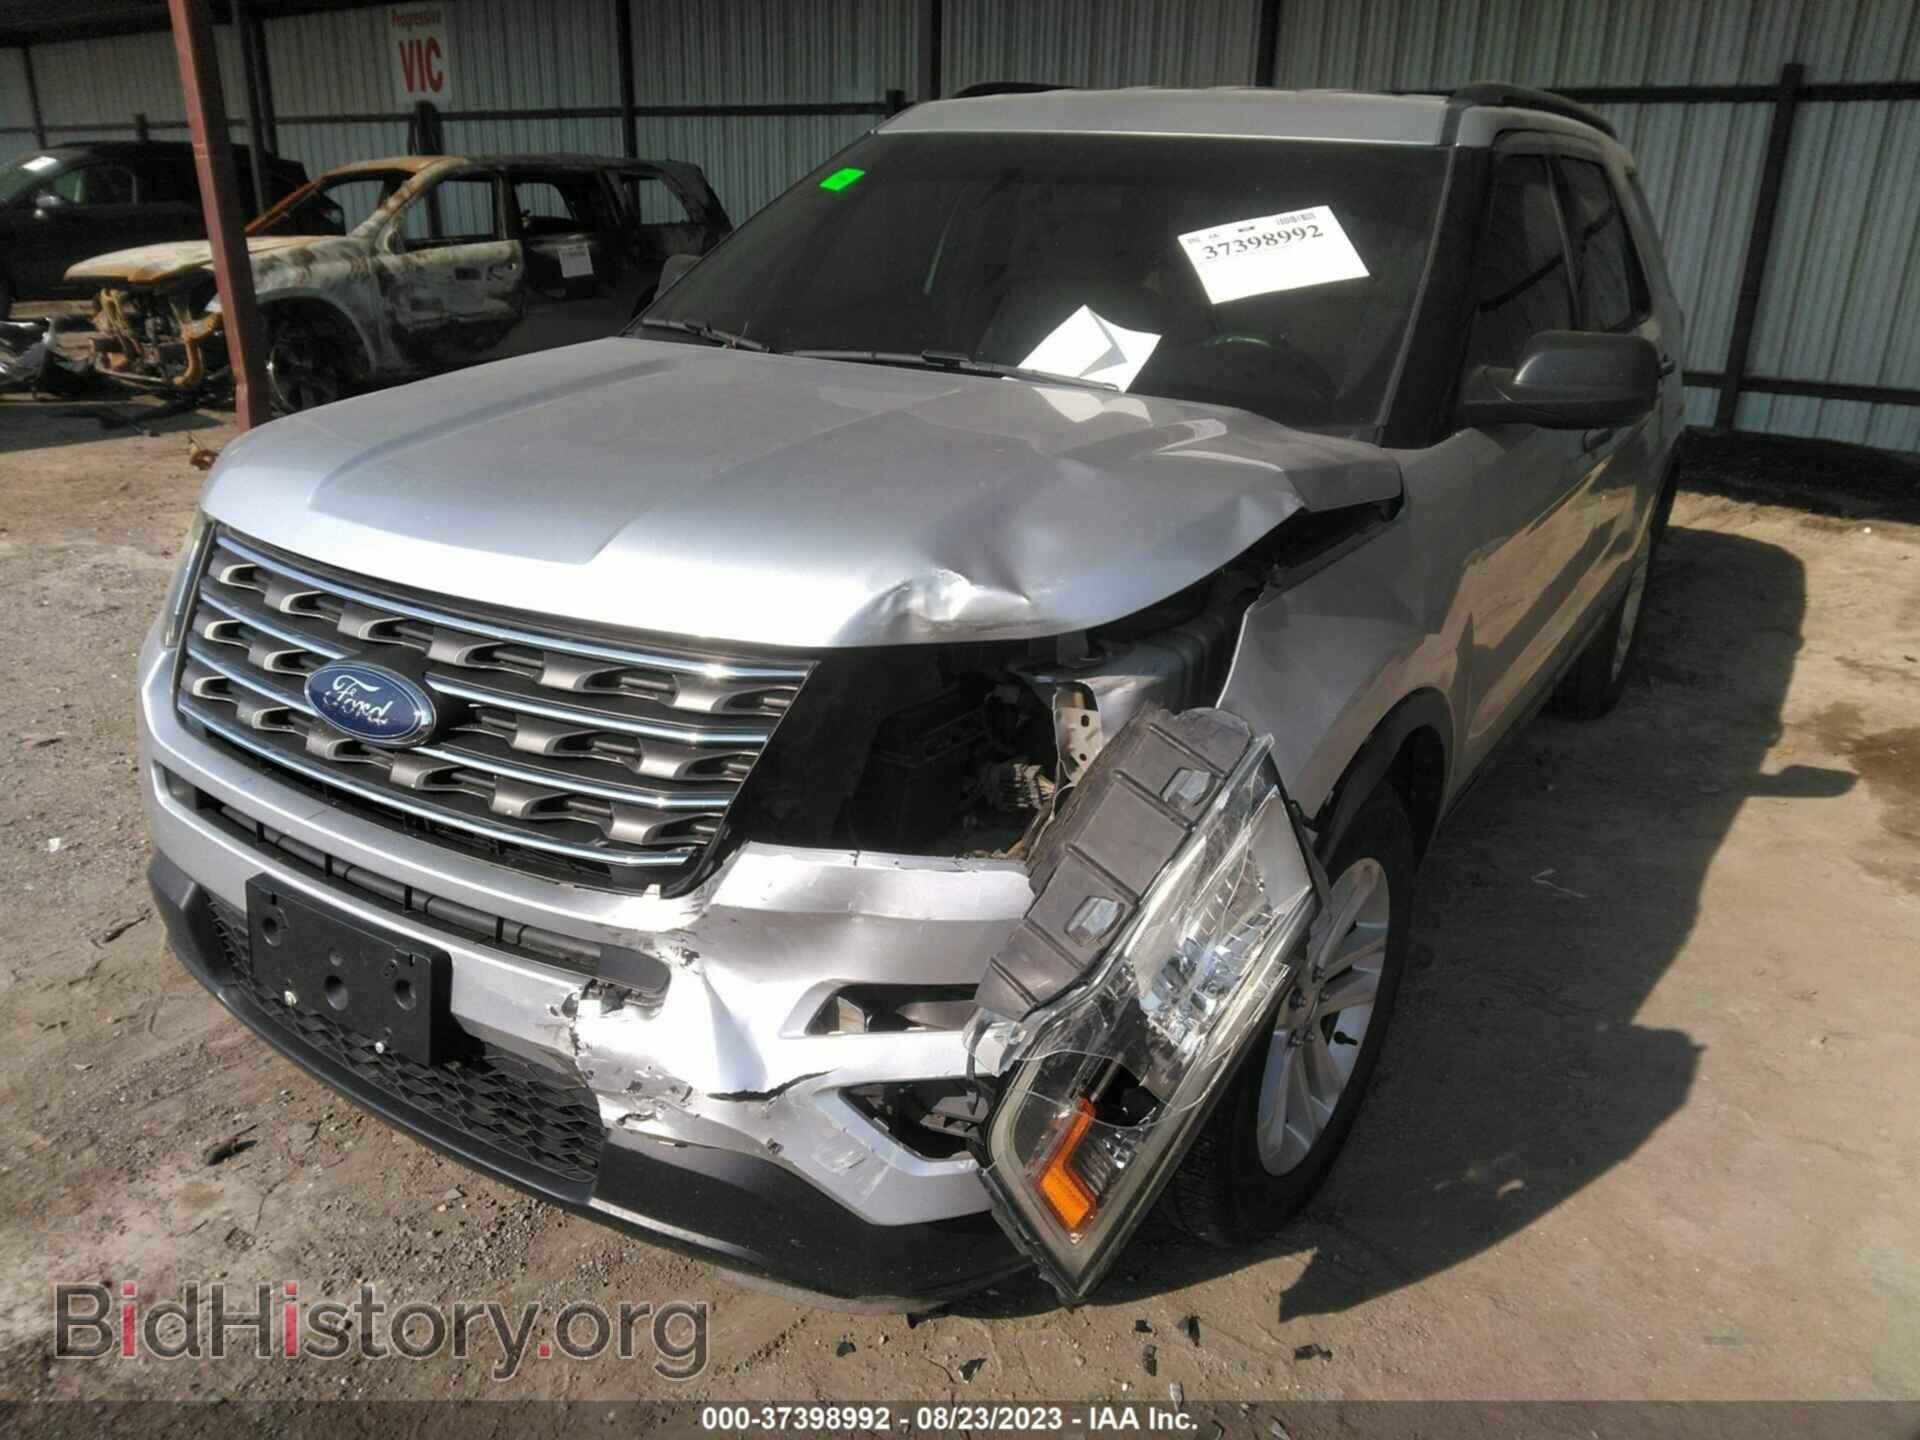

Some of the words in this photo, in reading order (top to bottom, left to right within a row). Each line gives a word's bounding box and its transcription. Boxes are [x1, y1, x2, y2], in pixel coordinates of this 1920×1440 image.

[398, 36, 444, 93] VIC
[1202, 223, 1324, 260] 37398992
[323, 674, 394, 726] Ford
